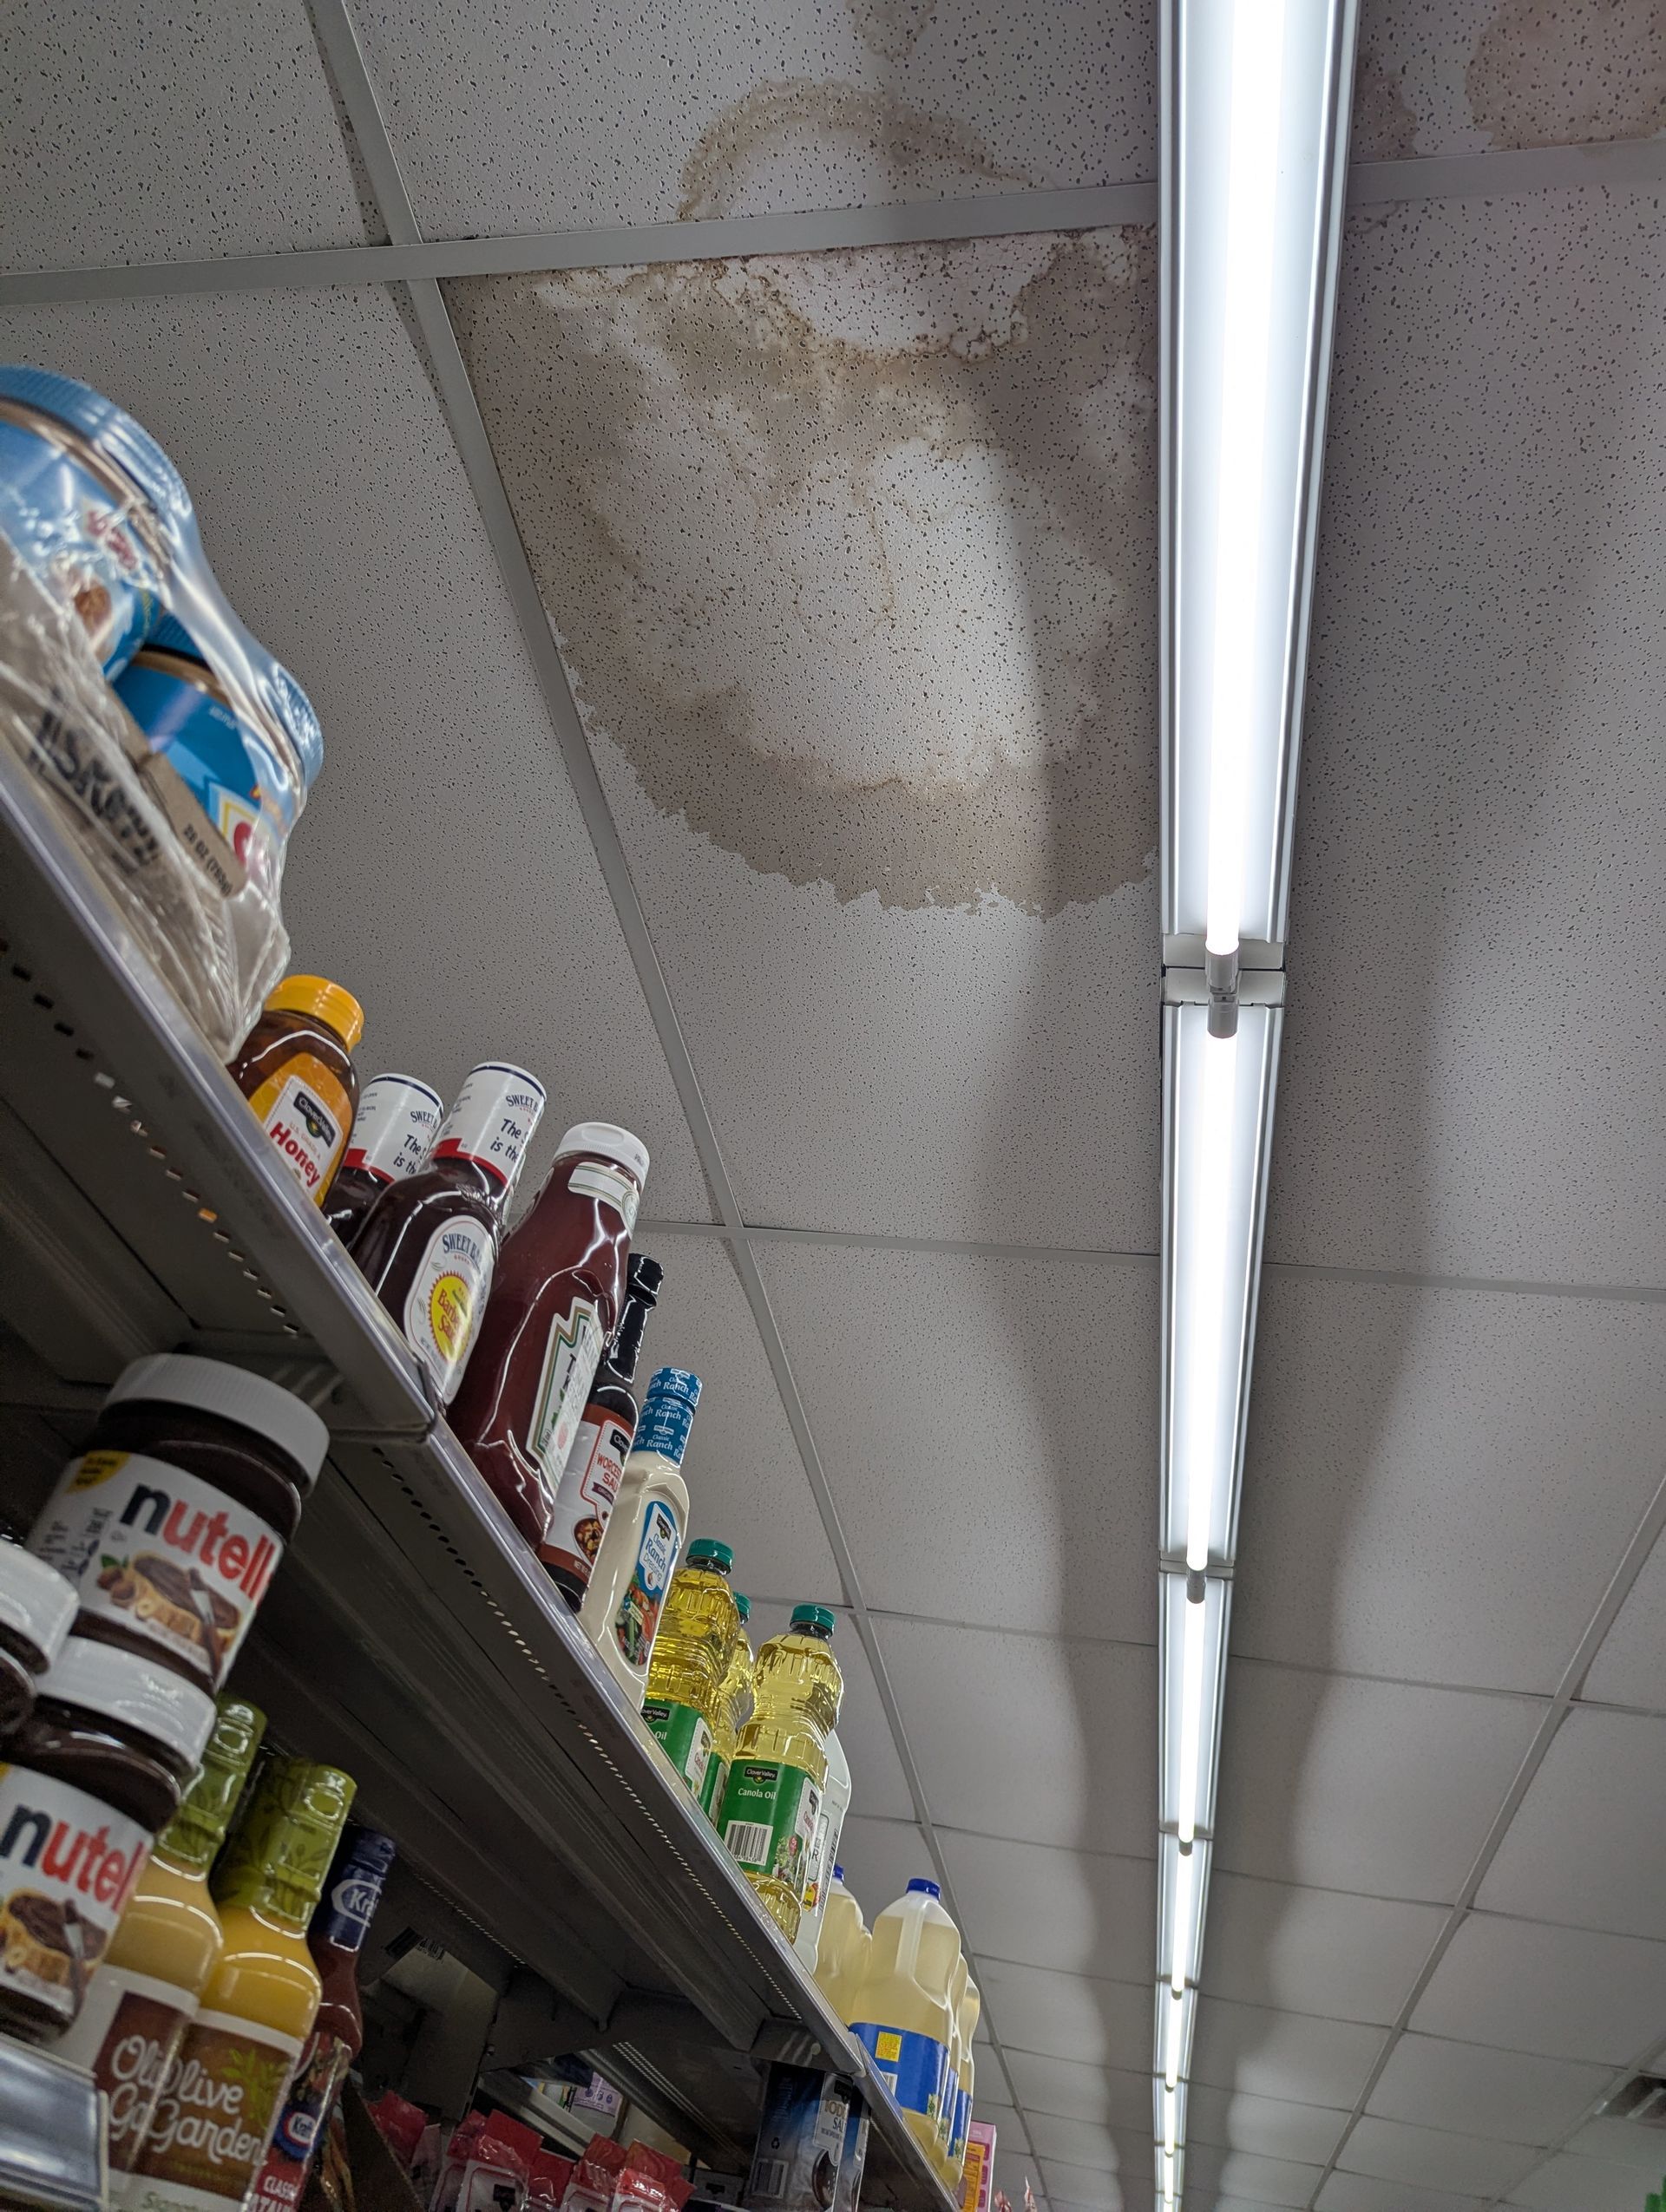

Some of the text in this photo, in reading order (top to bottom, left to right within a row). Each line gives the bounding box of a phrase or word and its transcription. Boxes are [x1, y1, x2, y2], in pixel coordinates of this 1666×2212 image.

[506, 1093, 535, 1108] SWEET
[410, 1110, 435, 1123] SWEET
[501, 1118, 521, 1139] The
[403, 1134, 422, 1155] The
[489, 1136, 503, 1152] is
[269, 1122, 321, 1188] Honey
[393, 1152, 405, 1168] is
[442, 1233, 471, 1254] SWEET
[663, 1381, 689, 1394] Ranch
[654, 1409, 681, 1421] Ranch
[646, 1439, 673, 1451] Ranch
[120, 1482, 275, 1600] nutell
[653, 1532, 666, 1556] Classic
[645, 1537, 666, 1573] Ranch
[642, 1554, 662, 1583] Dressing
[654, 1731, 667, 1741] Oil
[738, 1787, 777, 1800] Canola Oil
[160, 2058, 244, 2114] Olive
[148, 2097, 267, 2165] Garden
